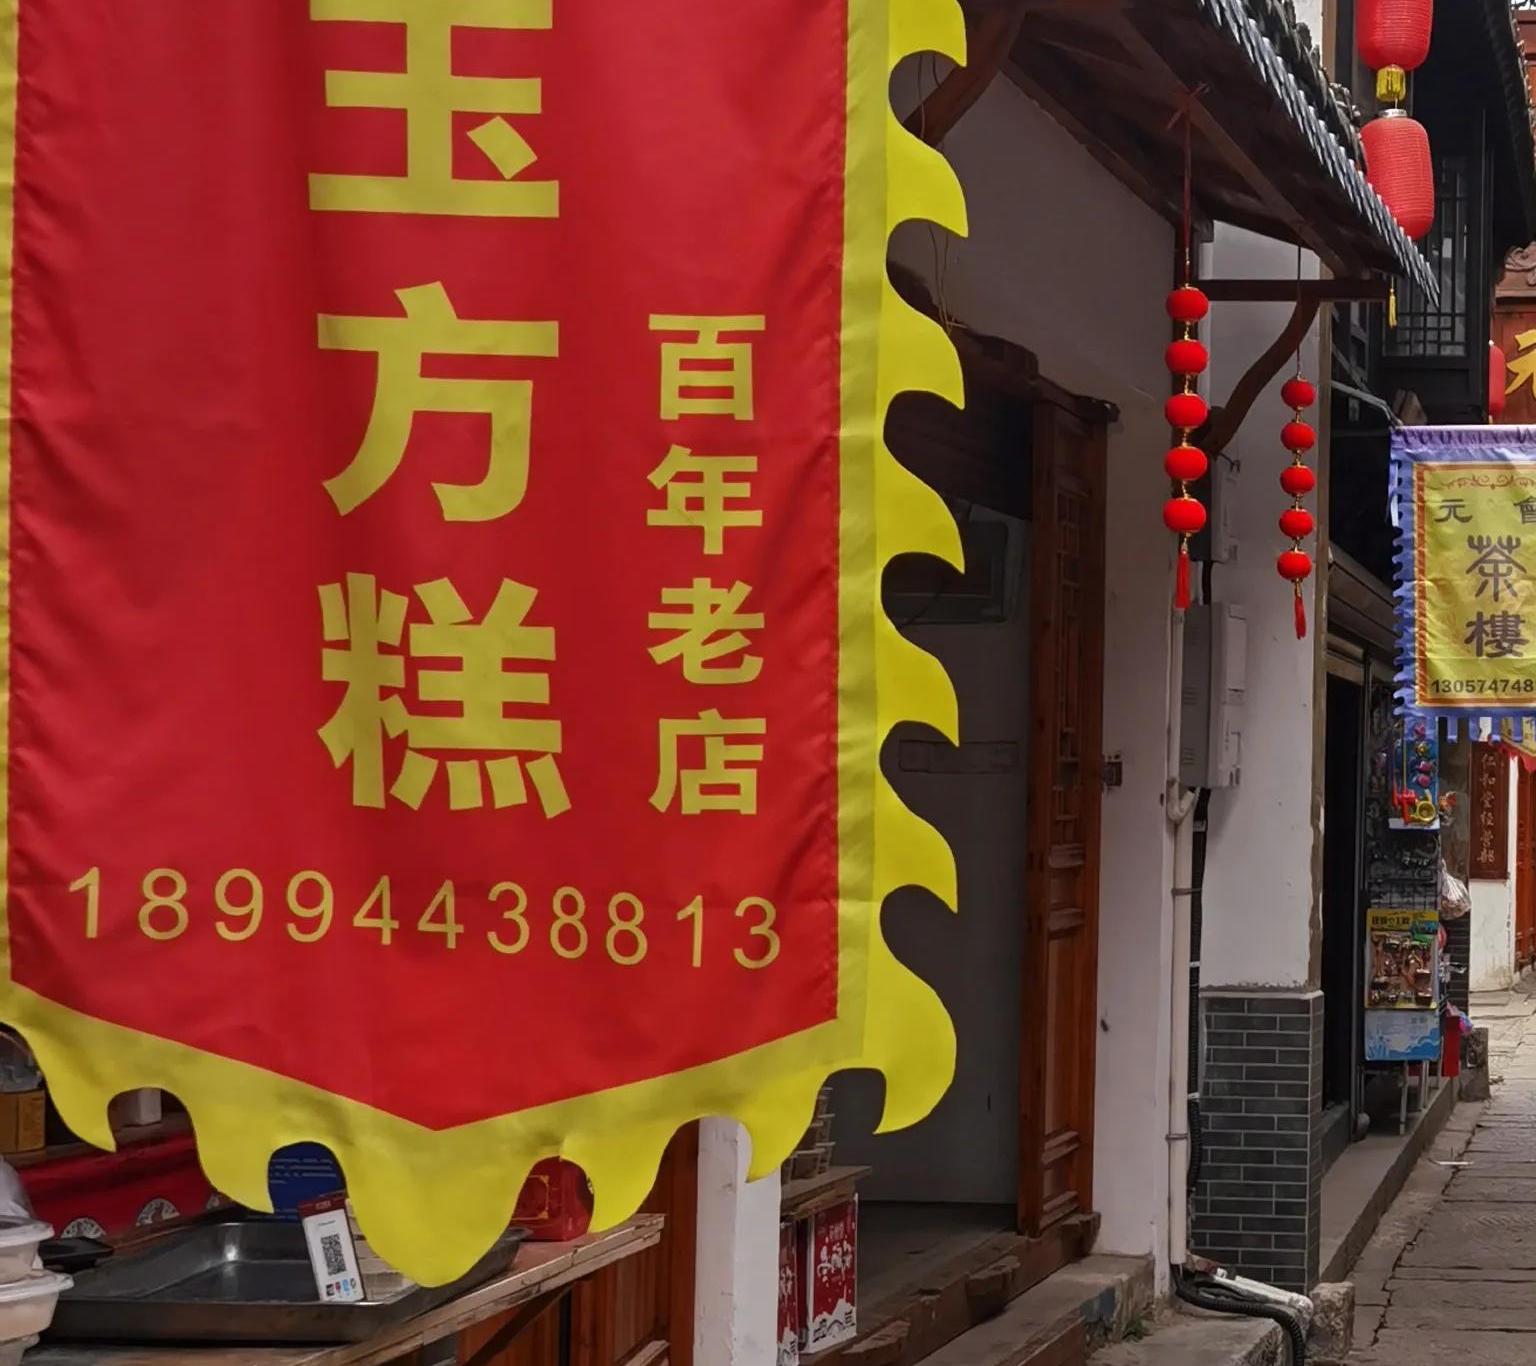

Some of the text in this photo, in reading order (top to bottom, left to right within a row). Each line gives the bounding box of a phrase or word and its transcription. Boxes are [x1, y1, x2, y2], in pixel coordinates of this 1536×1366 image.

[645, 313, 767, 816] 百年老店
[69, 866, 781, 969] 18994438813
